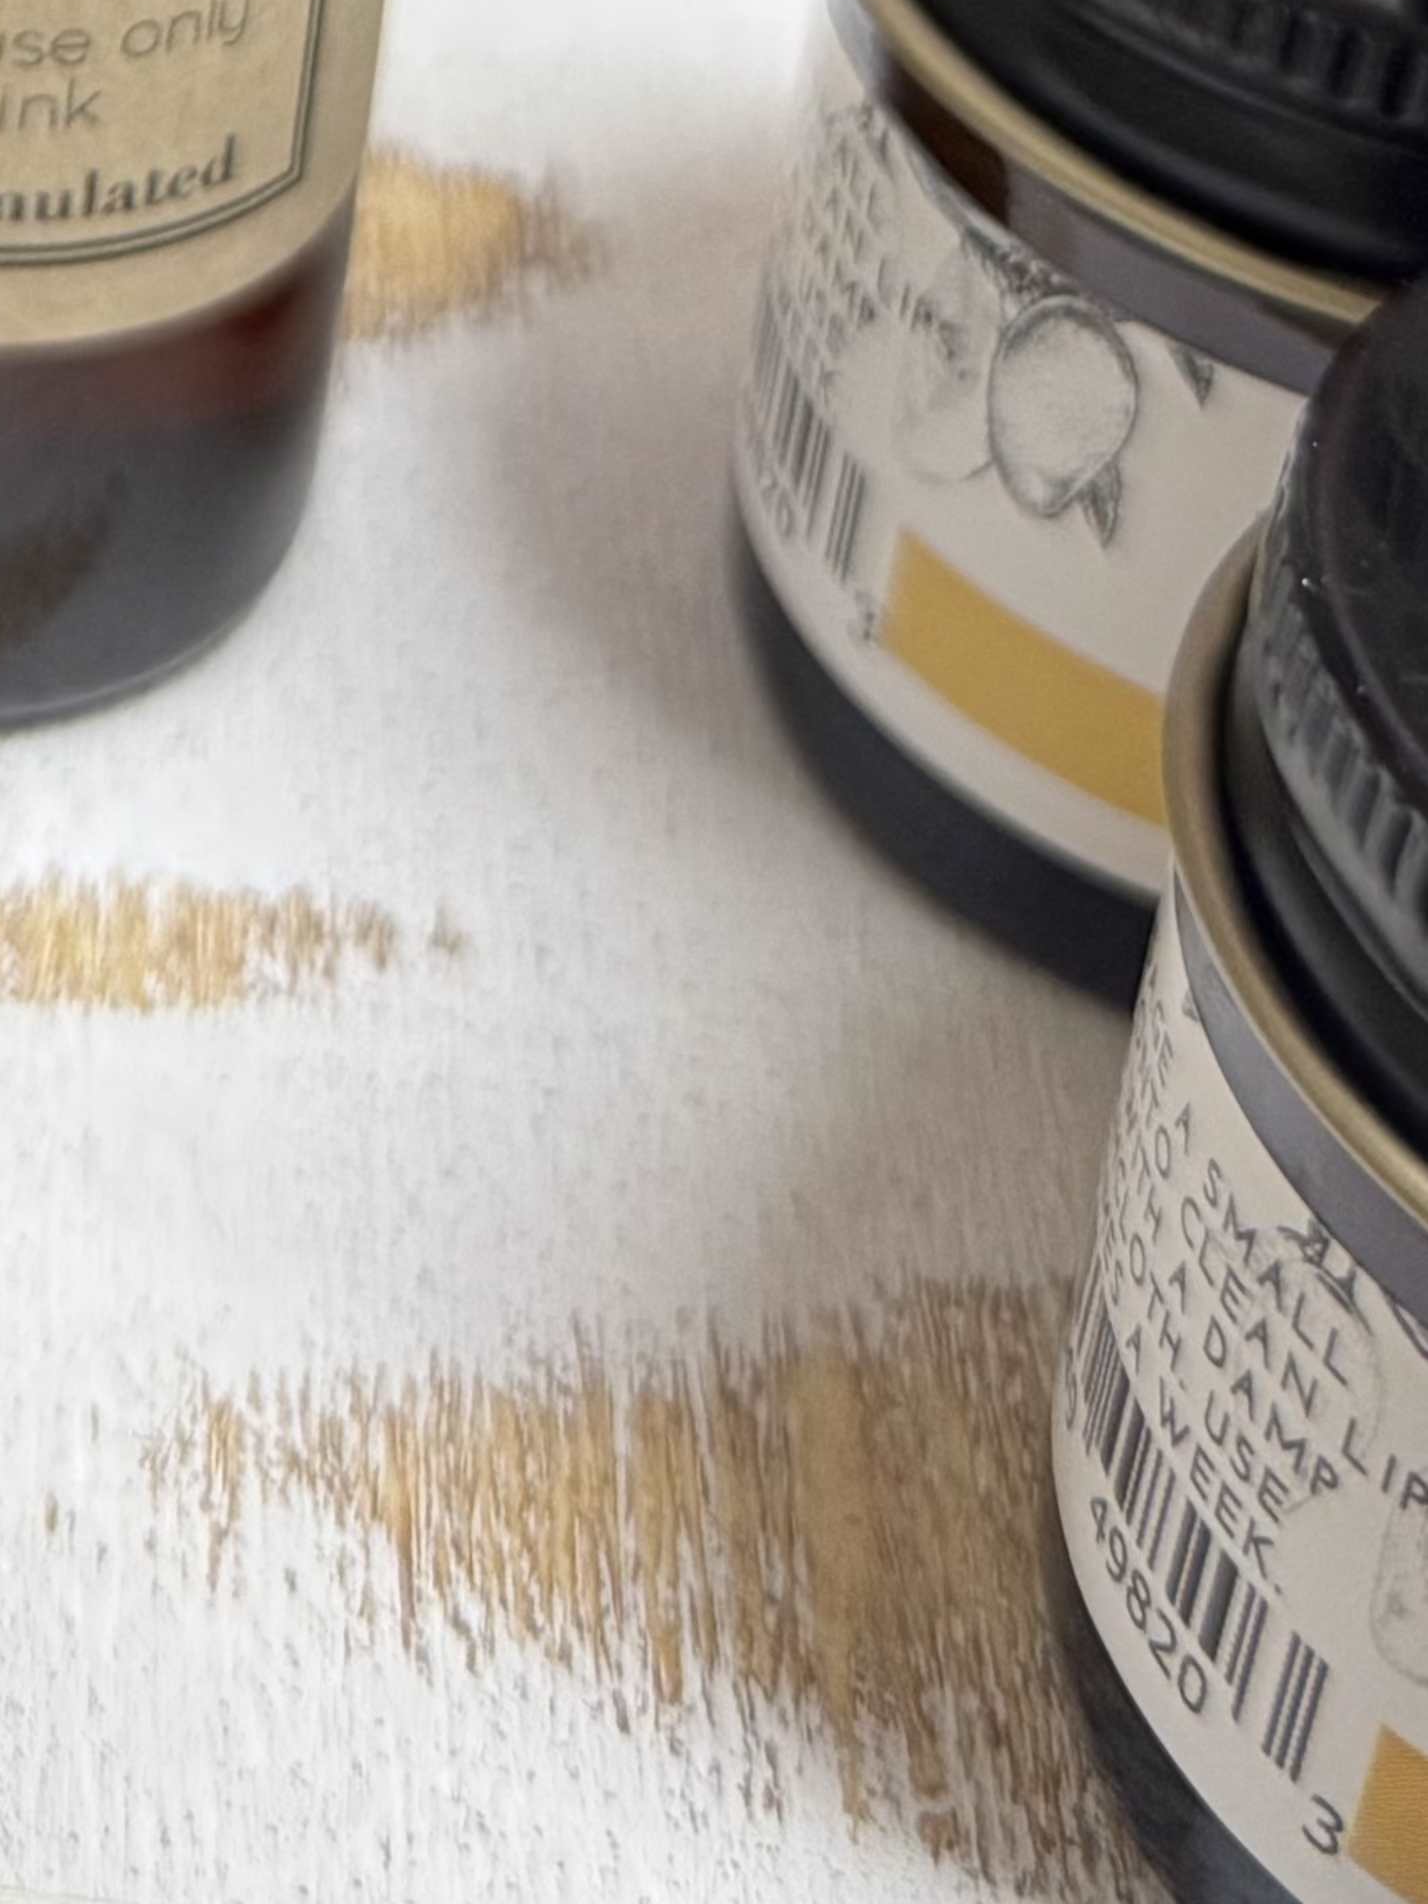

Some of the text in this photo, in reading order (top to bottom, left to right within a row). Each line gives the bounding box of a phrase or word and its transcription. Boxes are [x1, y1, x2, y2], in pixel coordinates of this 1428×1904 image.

[1180, 1196, 1319, 1419] CLEAN
[1203, 1158, 1349, 1388] SMALL
[1159, 1375, 1283, 1595] WEEK.
[1203, 1314, 1340, 1495] DAMP
[1204, 1390, 1290, 1525] USE
[1302, 1793, 1346, 1858] 3
